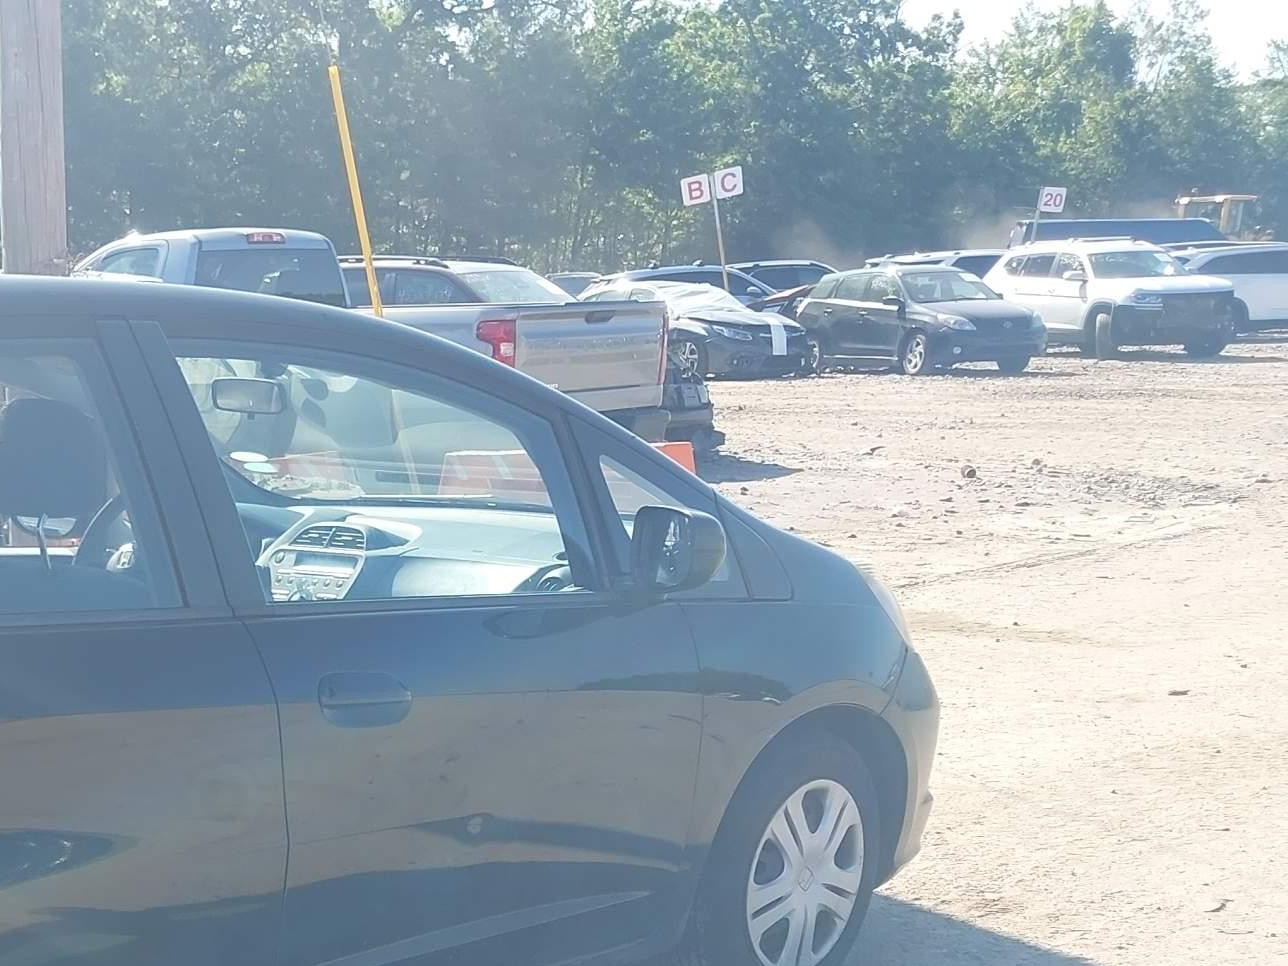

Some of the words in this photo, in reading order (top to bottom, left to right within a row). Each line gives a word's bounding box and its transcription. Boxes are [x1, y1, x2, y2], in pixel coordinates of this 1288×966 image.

[688, 181, 704, 200] B
[721, 173, 737, 192] C
[1043, 193, 1063, 207] 20
